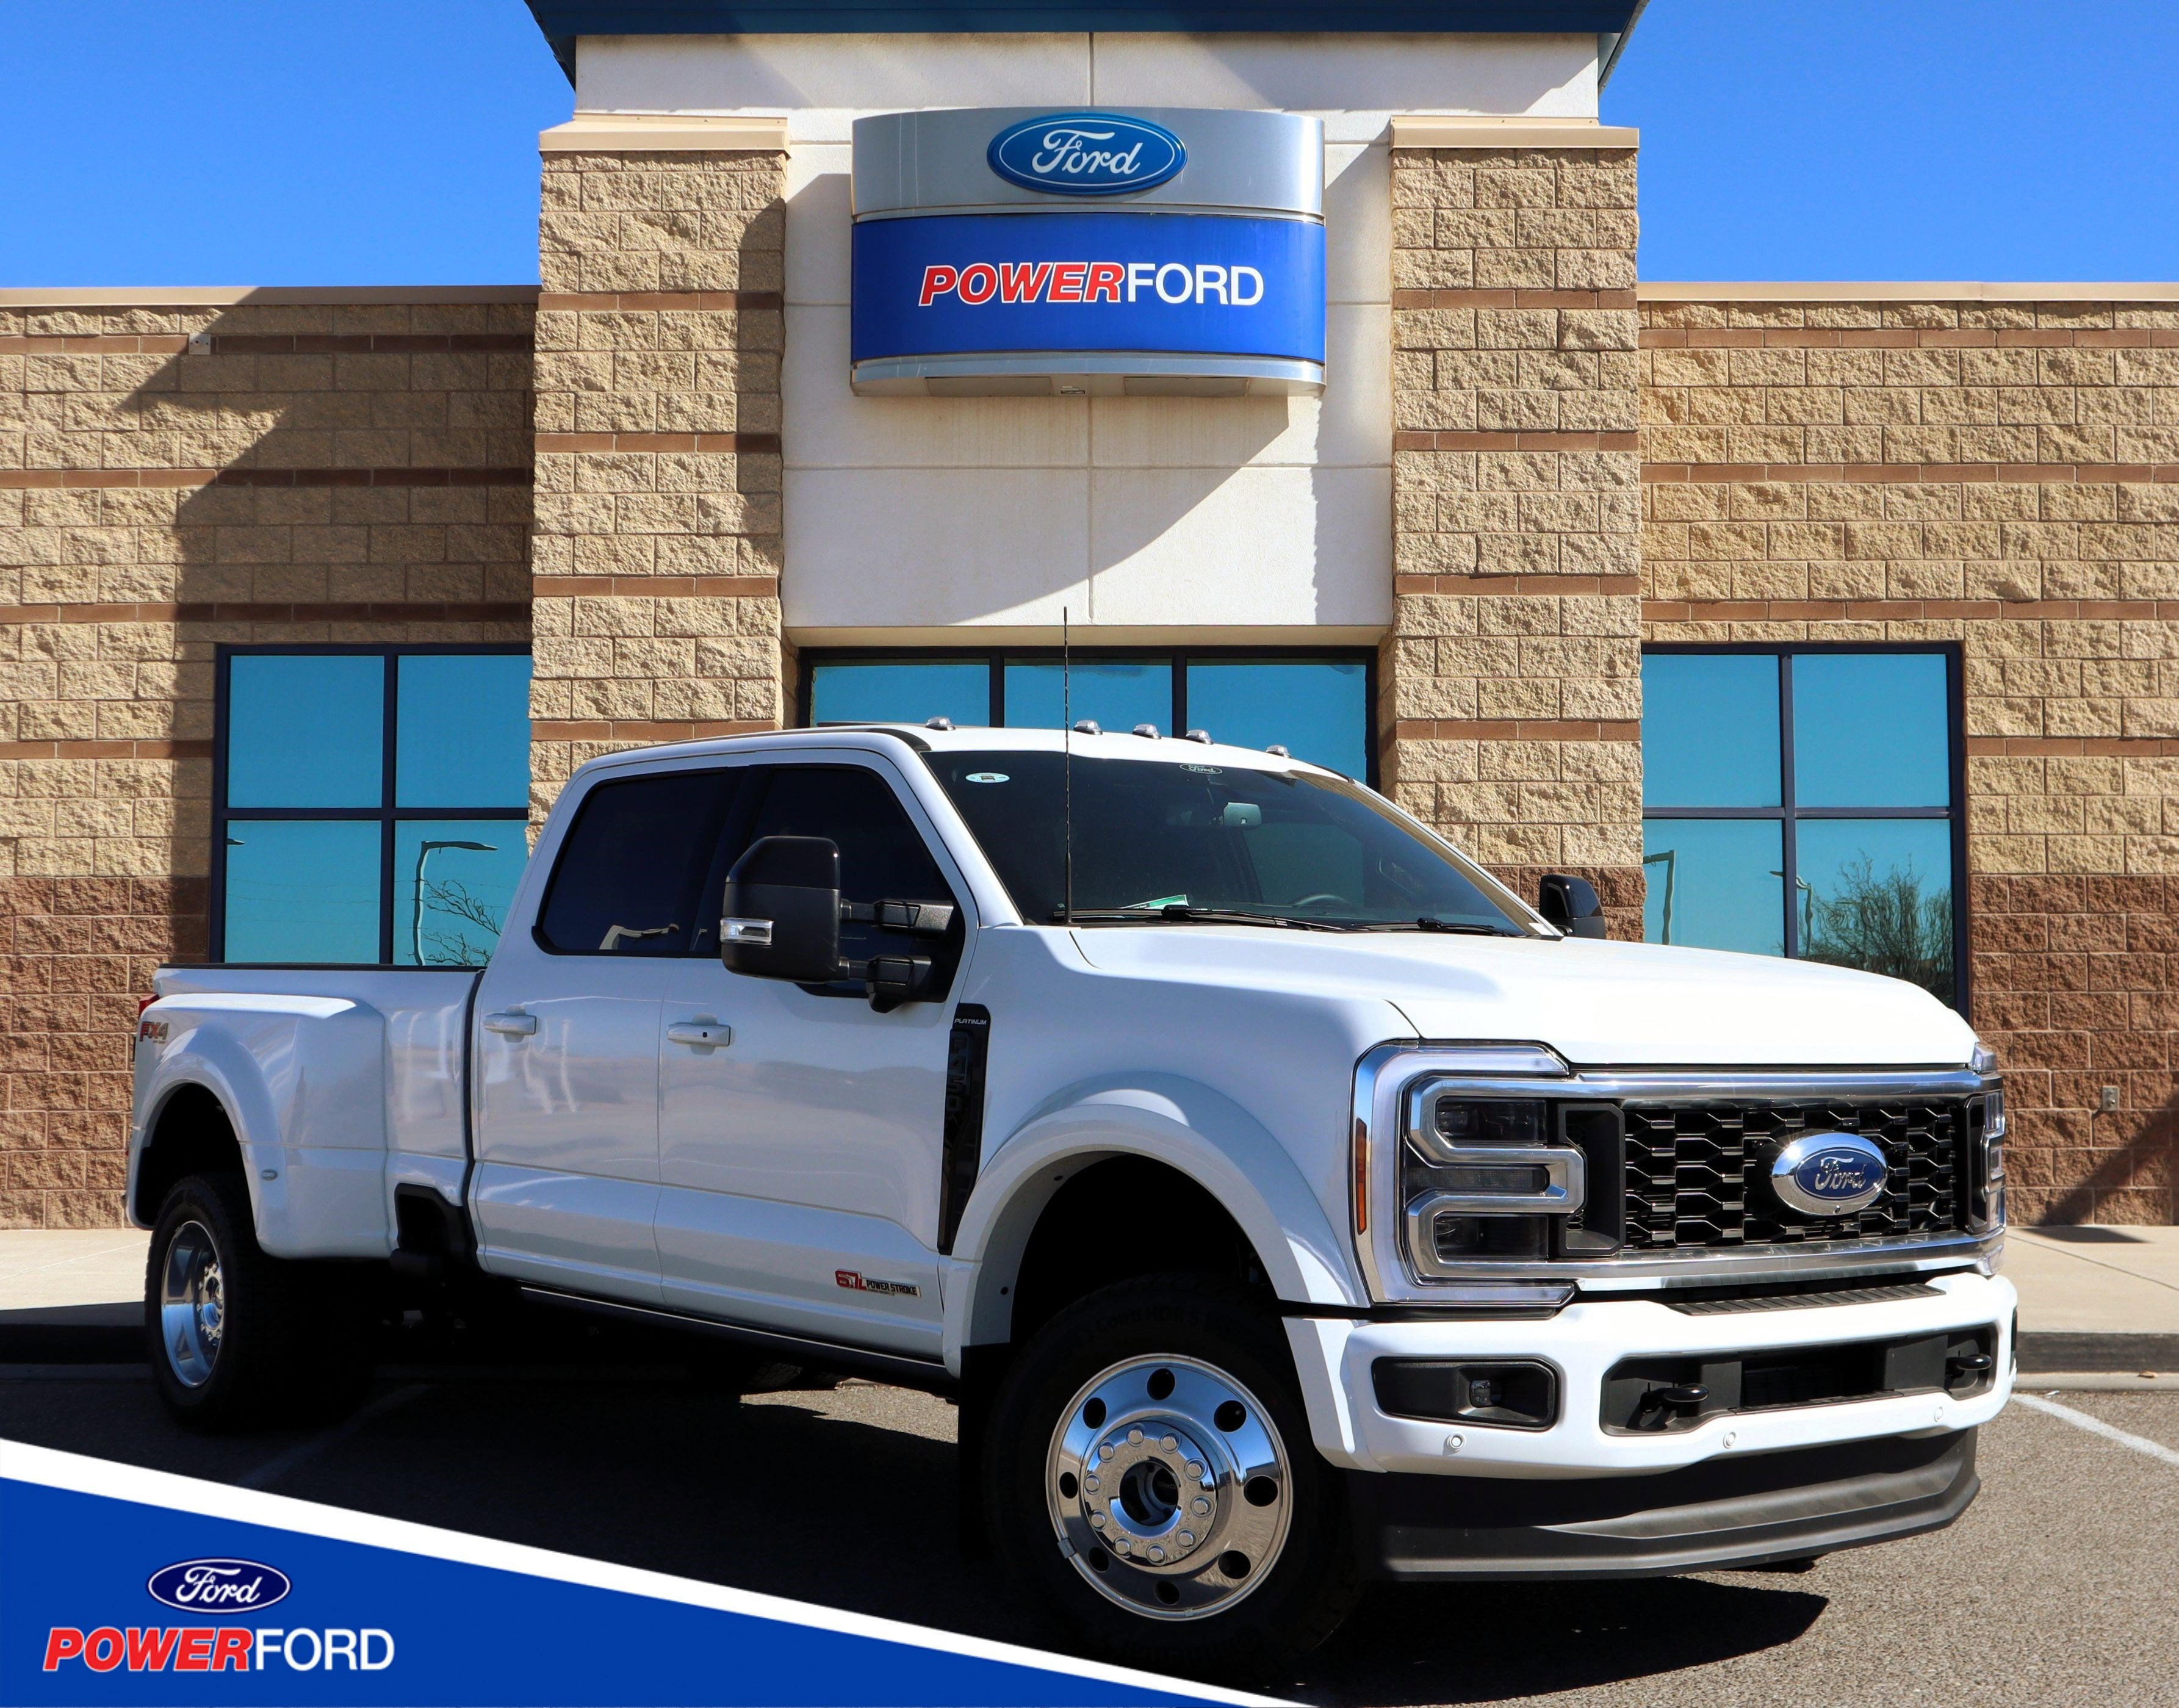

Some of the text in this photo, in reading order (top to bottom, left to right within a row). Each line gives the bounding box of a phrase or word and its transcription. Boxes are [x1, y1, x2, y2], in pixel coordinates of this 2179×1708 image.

[1031, 129, 1140, 175] Ford
[918, 261, 1264, 306] POWERFORD
[1187, 765, 1216, 773] Ford
[139, 1021, 169, 1042] FX4
[1814, 1156, 1868, 1191] Ford
[835, 1270, 867, 1291] 6.7L
[866, 1280, 890, 1291] POWER
[890, 1283, 918, 1295] STROKE
